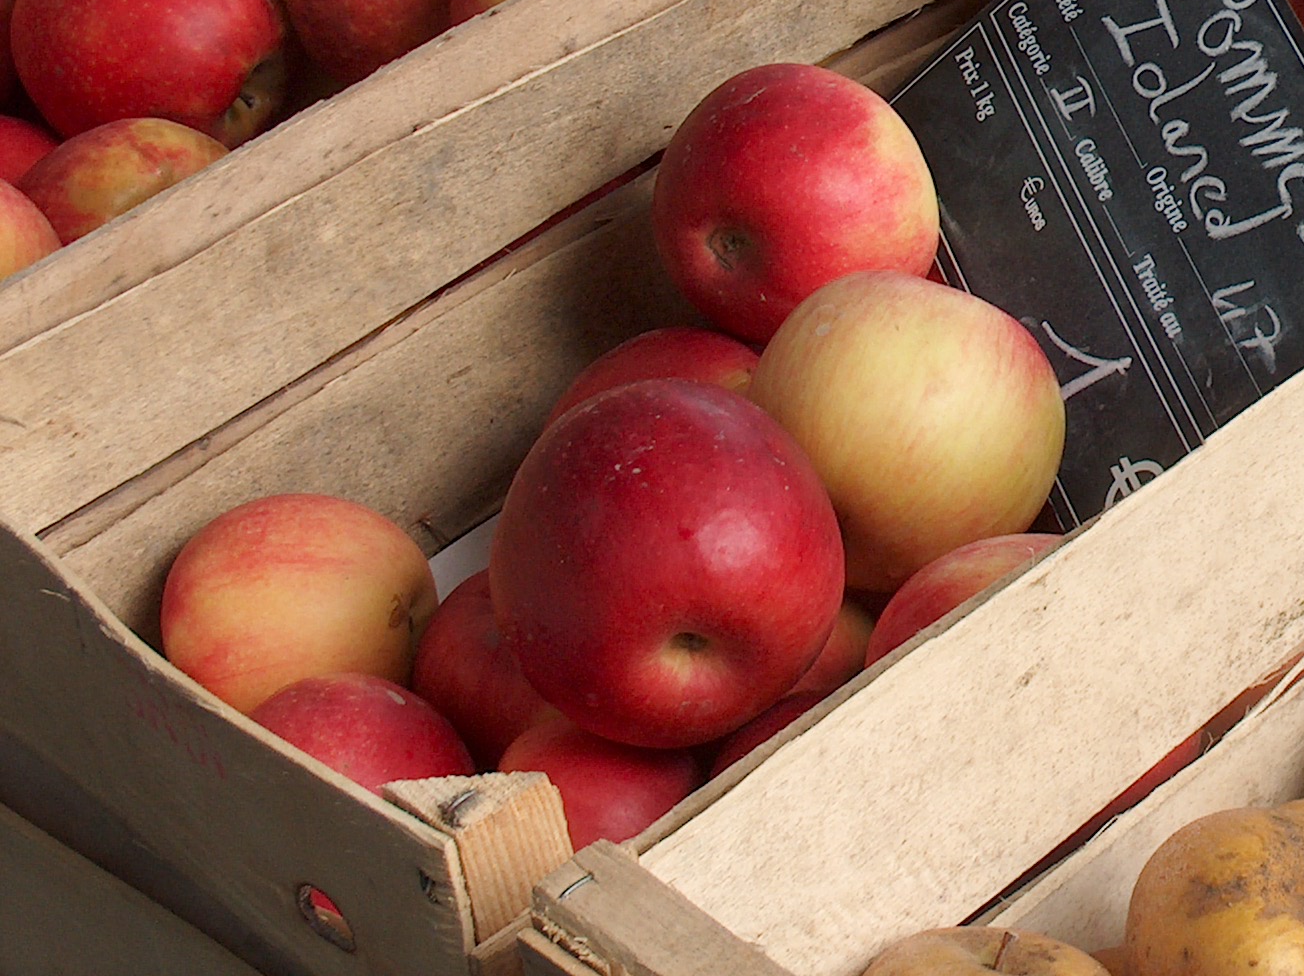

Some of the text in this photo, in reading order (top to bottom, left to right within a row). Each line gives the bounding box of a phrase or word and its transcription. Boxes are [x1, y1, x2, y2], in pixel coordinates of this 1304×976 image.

[954, 45, 996, 122] Prix 1 kg
[1007, 0, 1053, 76] Catégorie
[1074, 138, 1115, 202] Calibre
[1132, 253, 1176, 312] Traité
[1159, 311, 1184, 339] au
[1146, 165, 1189, 234] Origine
